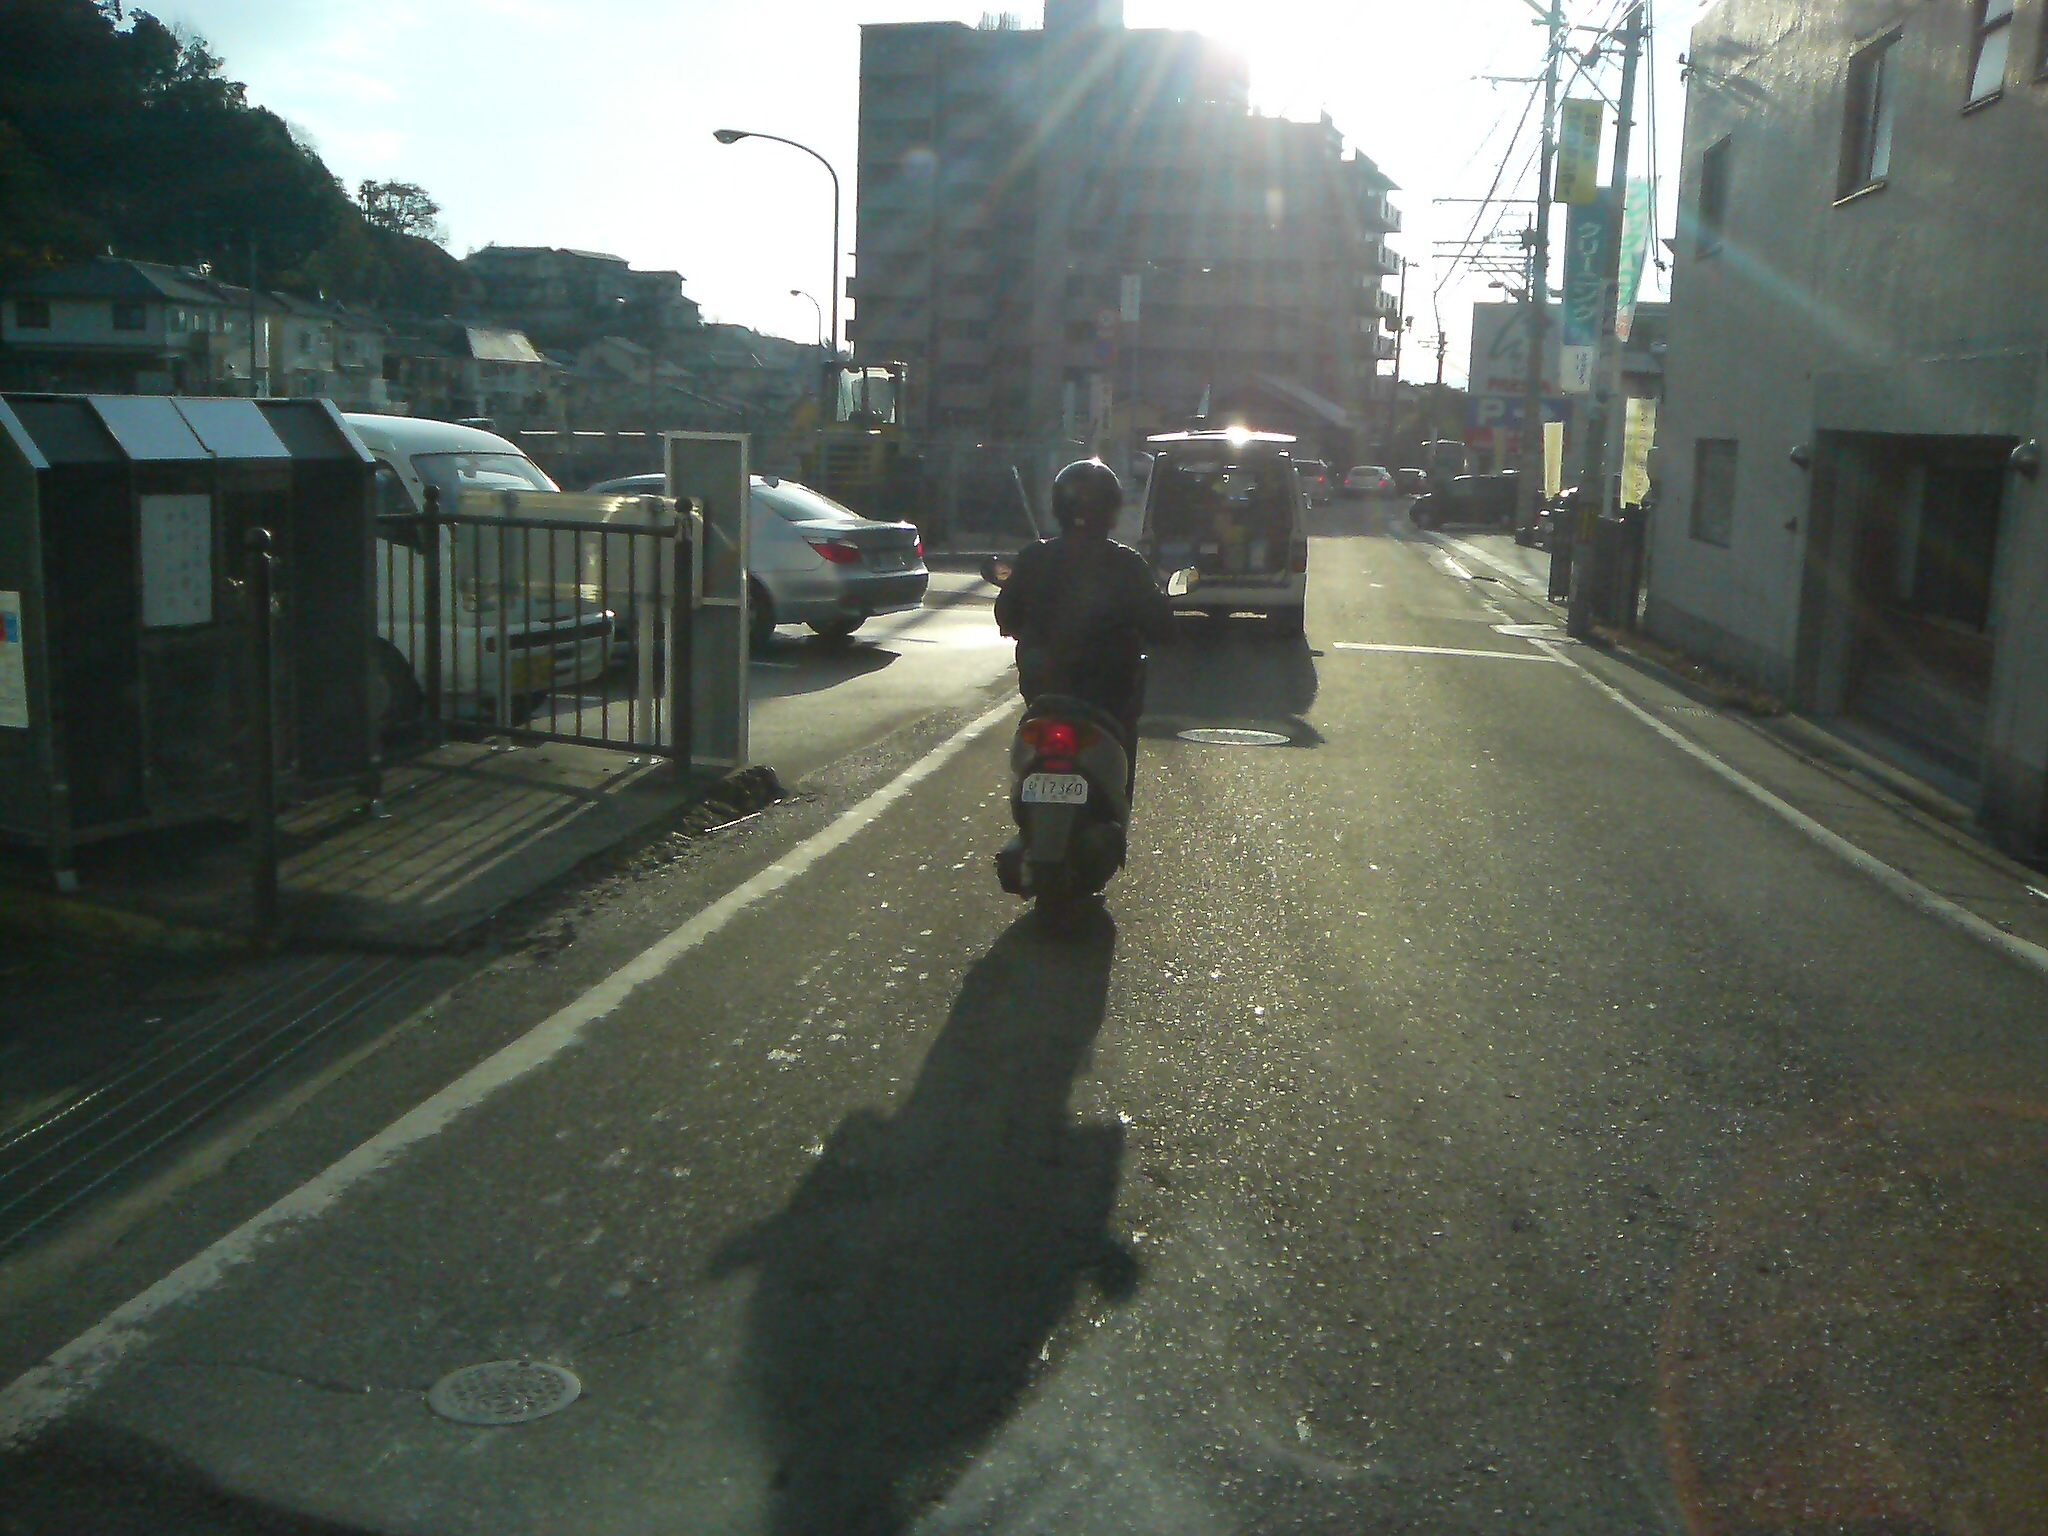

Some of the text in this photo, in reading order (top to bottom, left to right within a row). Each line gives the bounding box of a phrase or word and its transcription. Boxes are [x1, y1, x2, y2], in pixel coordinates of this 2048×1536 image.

[1573, 221, 1602, 320] クリーニング
[1478, 399, 1505, 426] P
